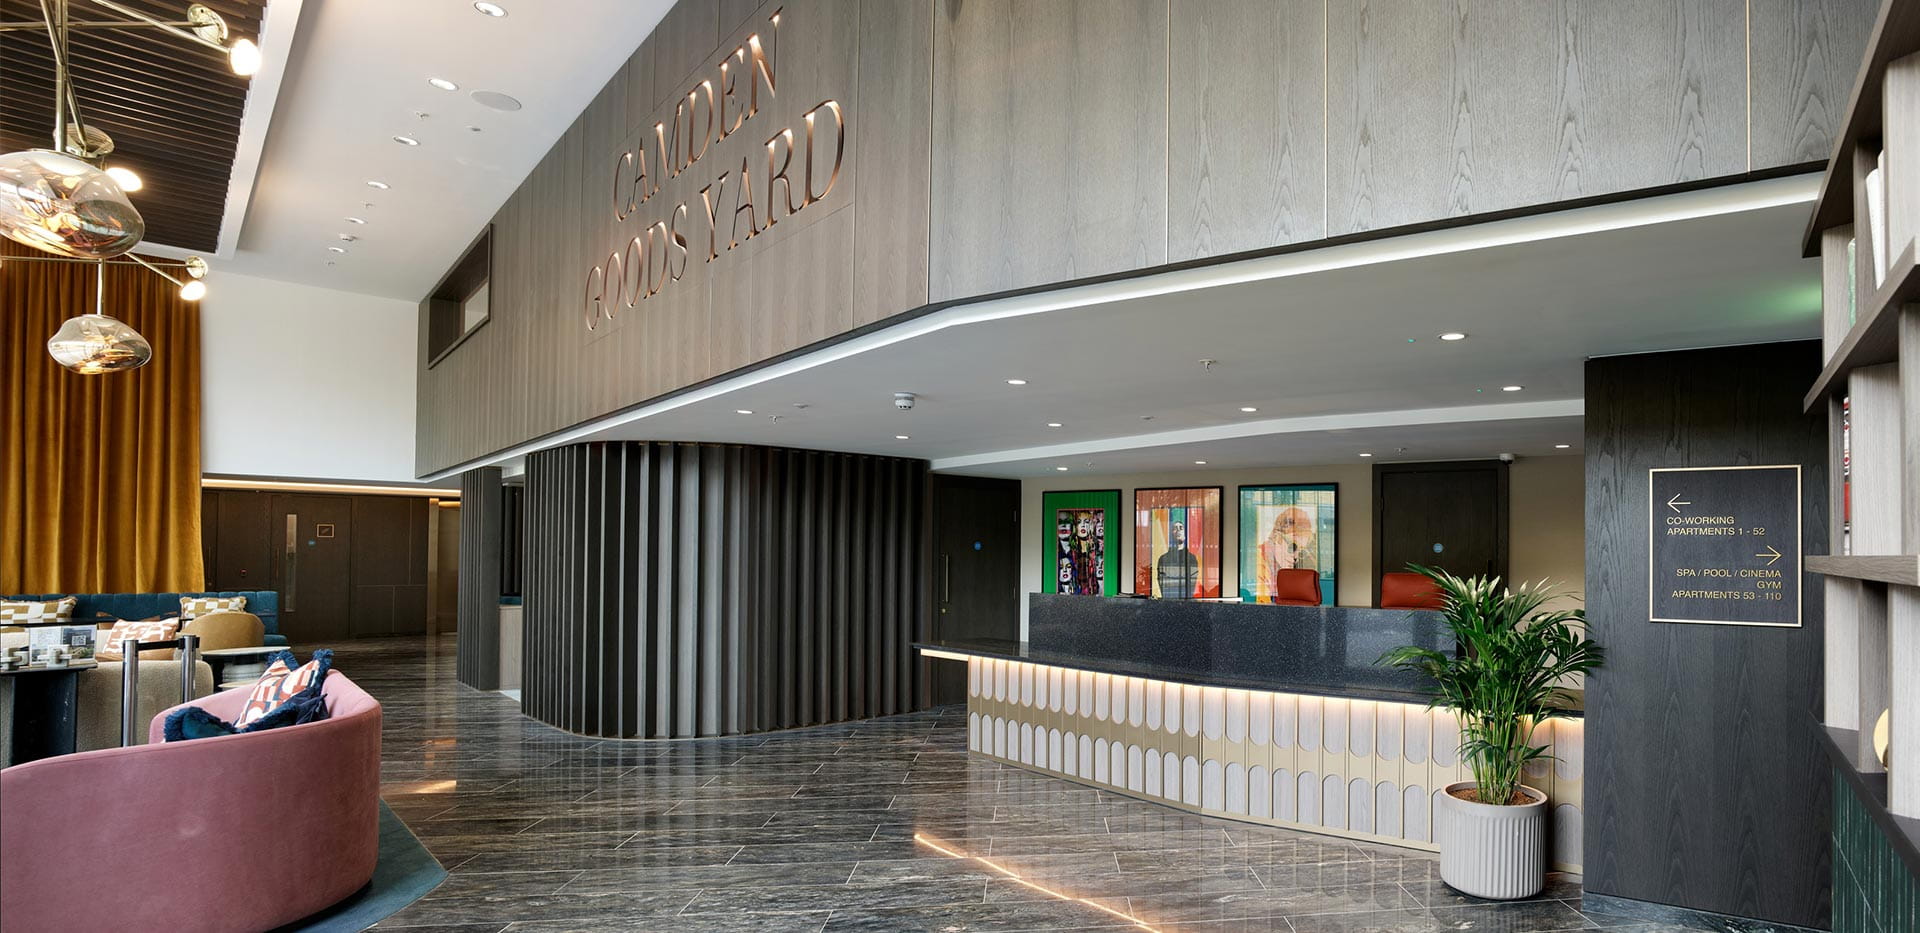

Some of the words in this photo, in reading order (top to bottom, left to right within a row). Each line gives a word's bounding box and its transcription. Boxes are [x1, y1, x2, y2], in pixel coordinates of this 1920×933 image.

[612, 5, 784, 223] CAMDEN
[584, 200, 689, 332] GOODS
[699, 98, 846, 265] YARD
[1666, 516, 1735, 525] CO-WORKING
[1666, 527, 1735, 536] APARTMENTS
[1738, 527, 1743, 536] 1
[1752, 527, 1766, 536] 52
[1676, 568, 1696, 577] SPA
[1703, 568, 1732, 578] POOL
[1740, 569, 1782, 578] CINEMA
[1756, 580, 1782, 590] GYM
[1672, 590, 1741, 599] APARTMENTS
[1743, 591, 1755, 600] 53
[1765, 592, 1782, 601] 110
